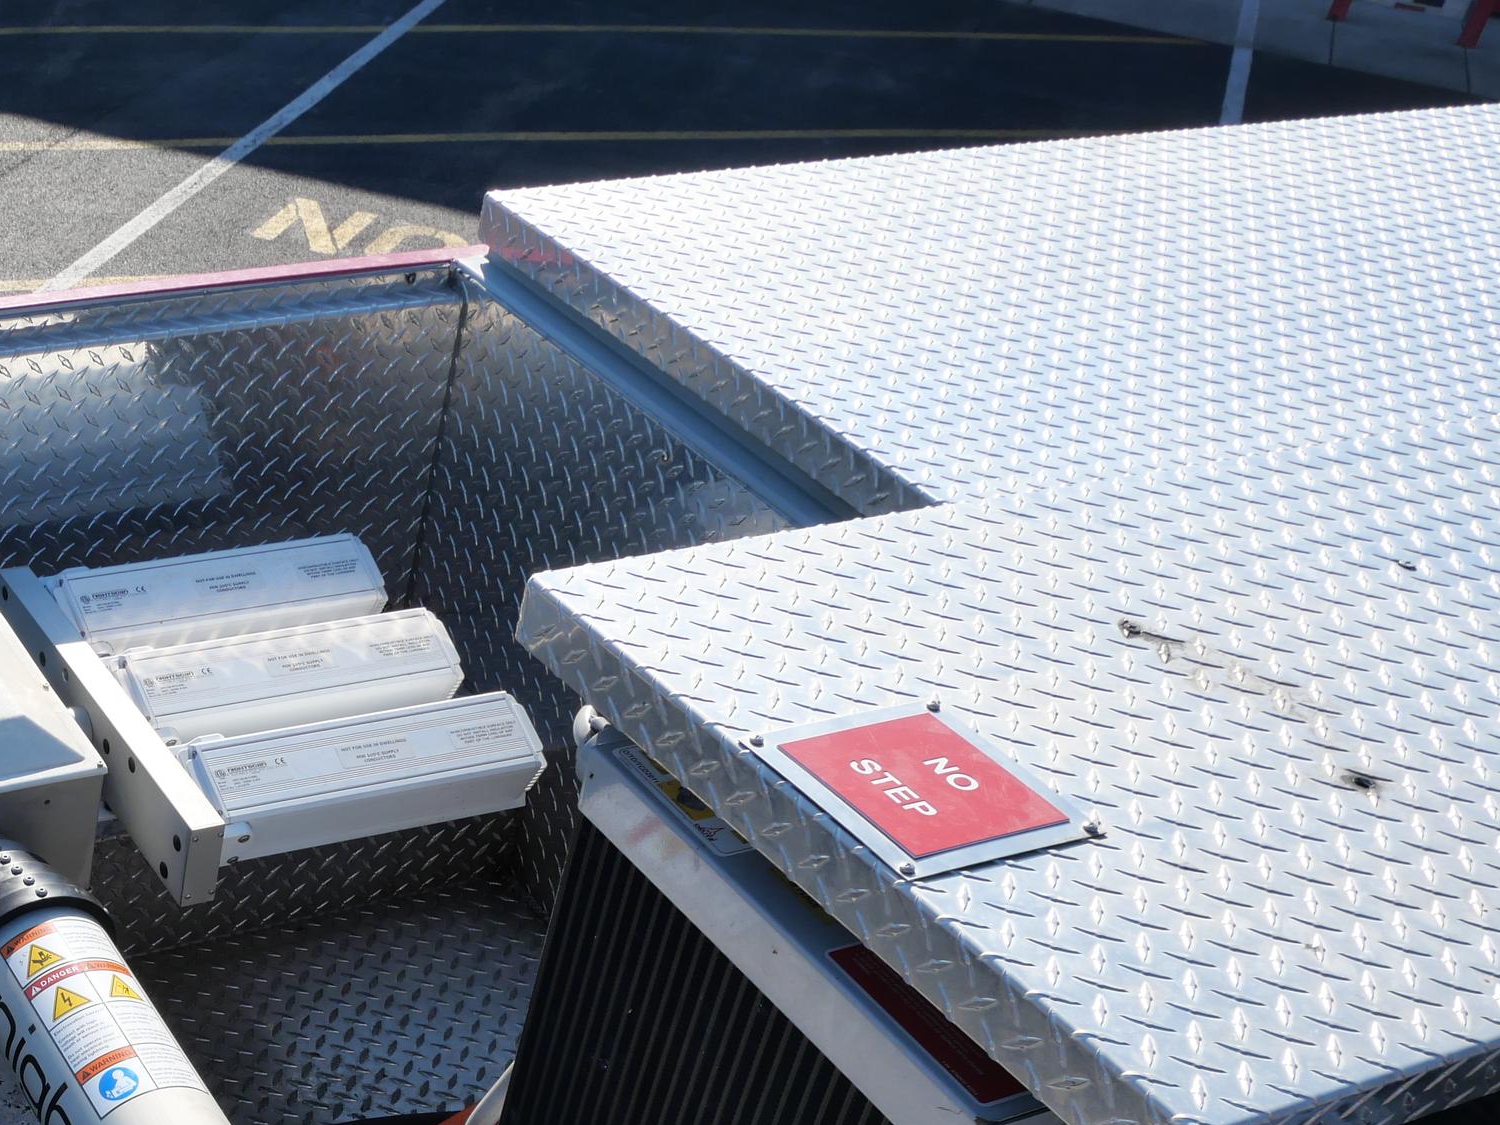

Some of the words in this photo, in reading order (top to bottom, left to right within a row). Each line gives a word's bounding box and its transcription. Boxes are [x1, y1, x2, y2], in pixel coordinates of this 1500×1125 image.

[849, 758, 938, 817] STEP
[922, 756, 980, 792] NO
[40, 967, 80, 987] DANGER
[90, 1050, 132, 1073] WARNING
